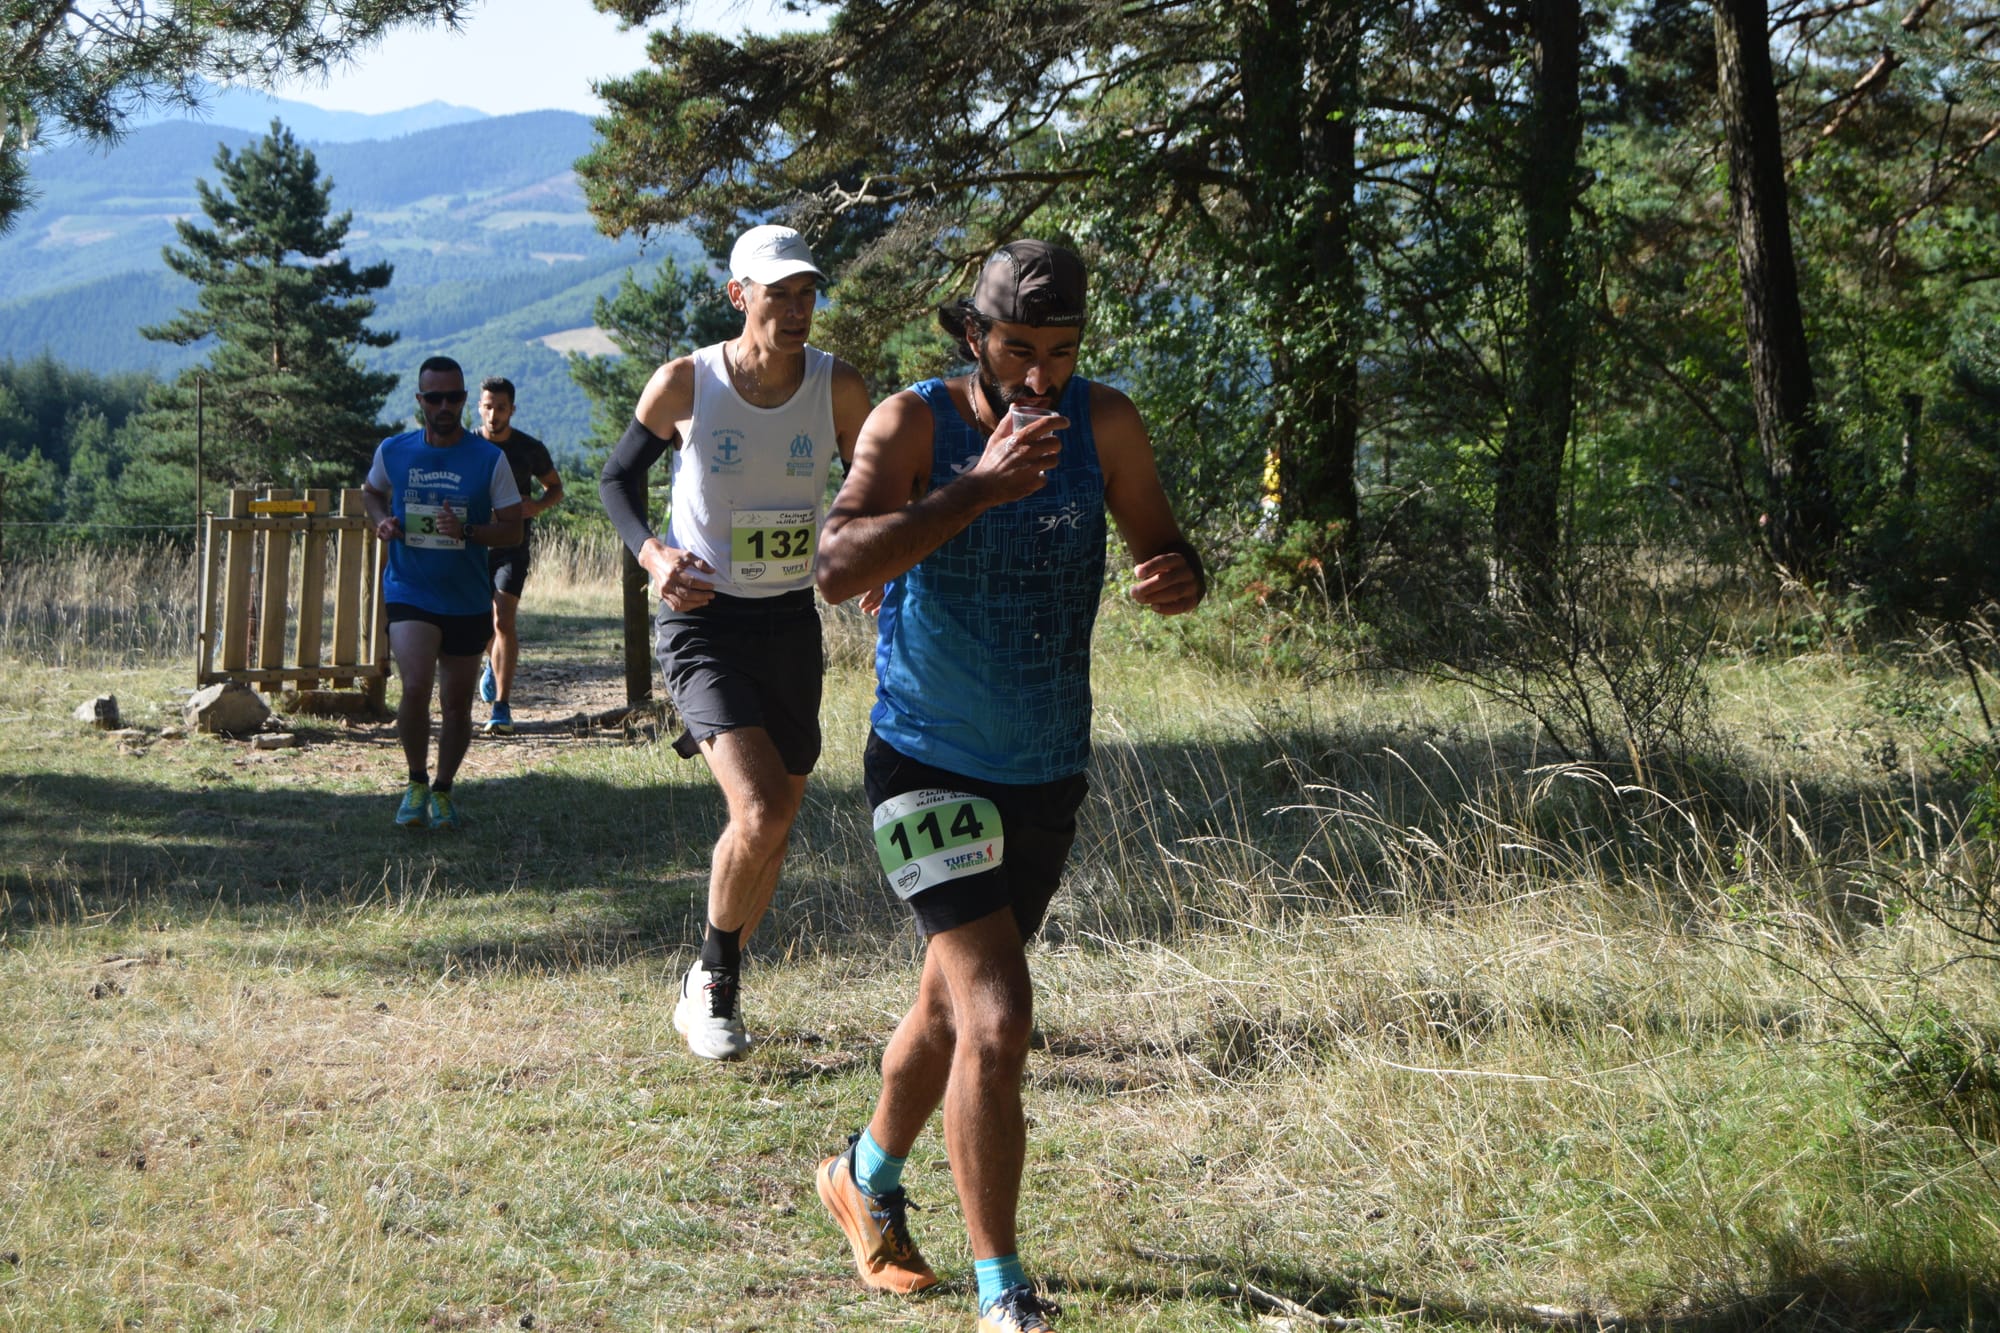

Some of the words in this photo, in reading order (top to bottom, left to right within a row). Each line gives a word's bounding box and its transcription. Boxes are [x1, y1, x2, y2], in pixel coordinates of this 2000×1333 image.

[748, 529, 810, 559] 132
[890, 803, 984, 861] 114
[943, 851, 984, 868] TUFF'S
[897, 871, 918, 888] BFP
